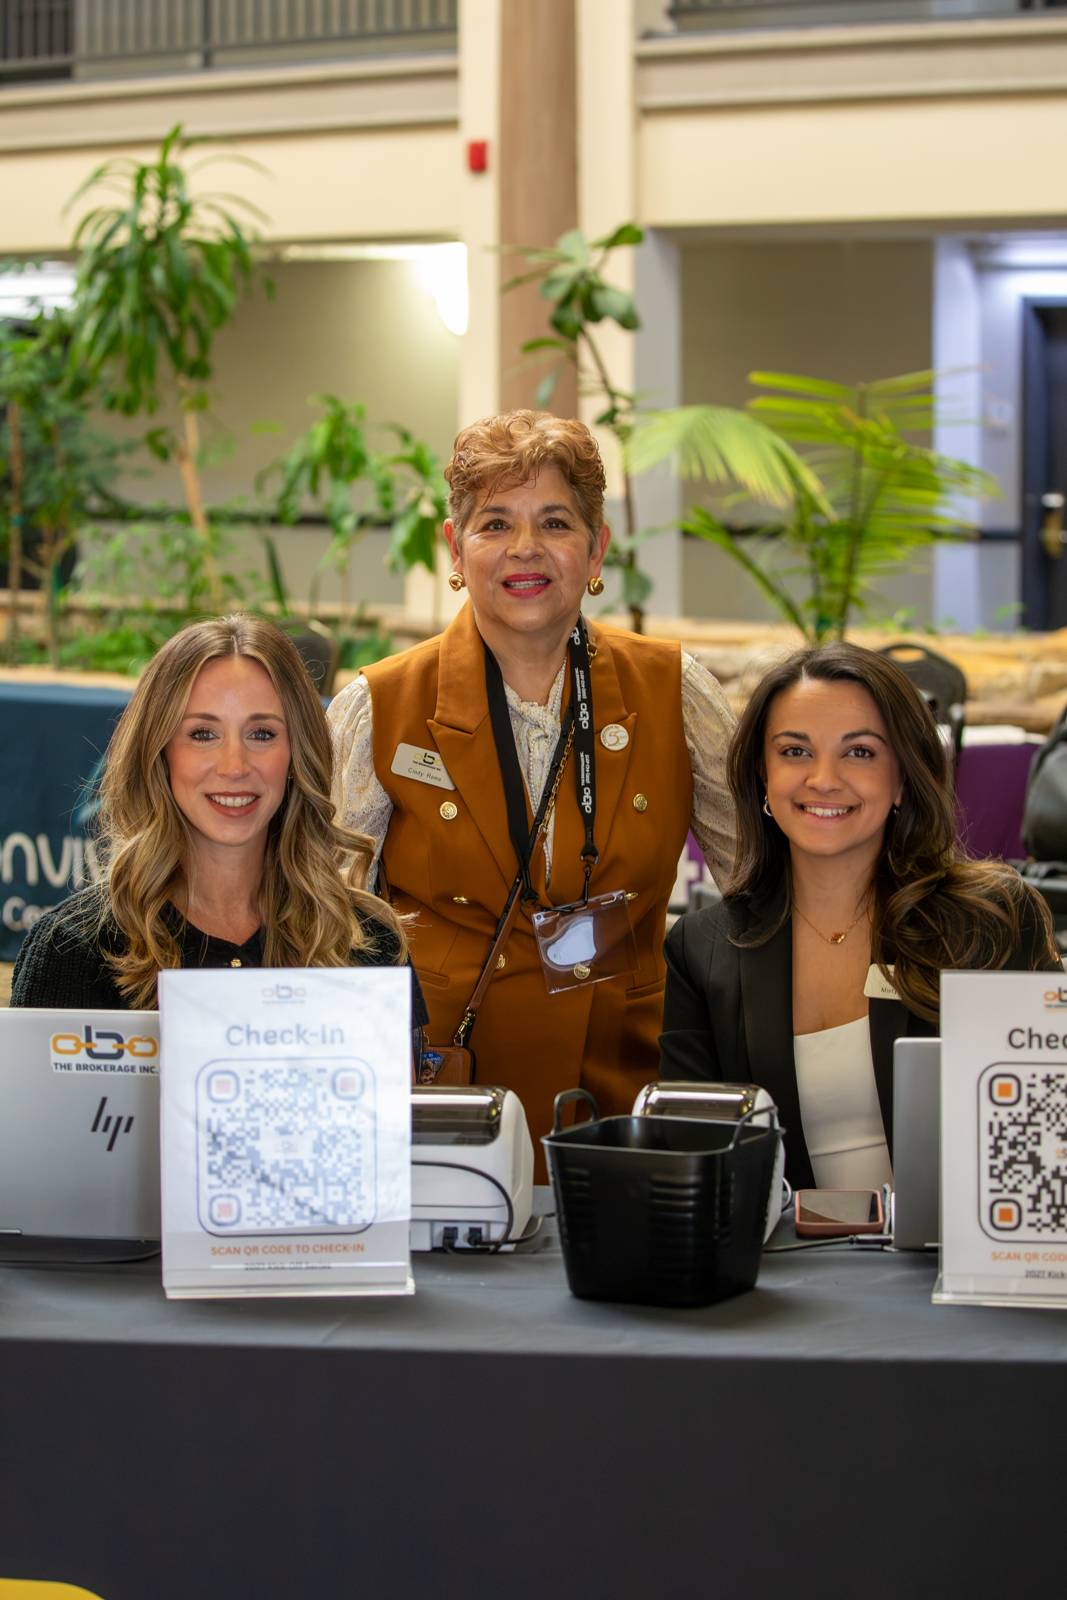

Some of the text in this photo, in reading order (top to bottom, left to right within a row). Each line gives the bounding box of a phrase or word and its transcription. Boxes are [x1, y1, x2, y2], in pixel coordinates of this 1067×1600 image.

[407, 767, 425, 778] Cindy
[226, 1022, 345, 1047] Check-In
[53, 1062, 159, 1075] THE BROKERAGE INC.
[210, 1243, 365, 1257] SCAN QR CODE TO CHECK-IN
[991, 1250, 1067, 1264] SCAN QR COD
